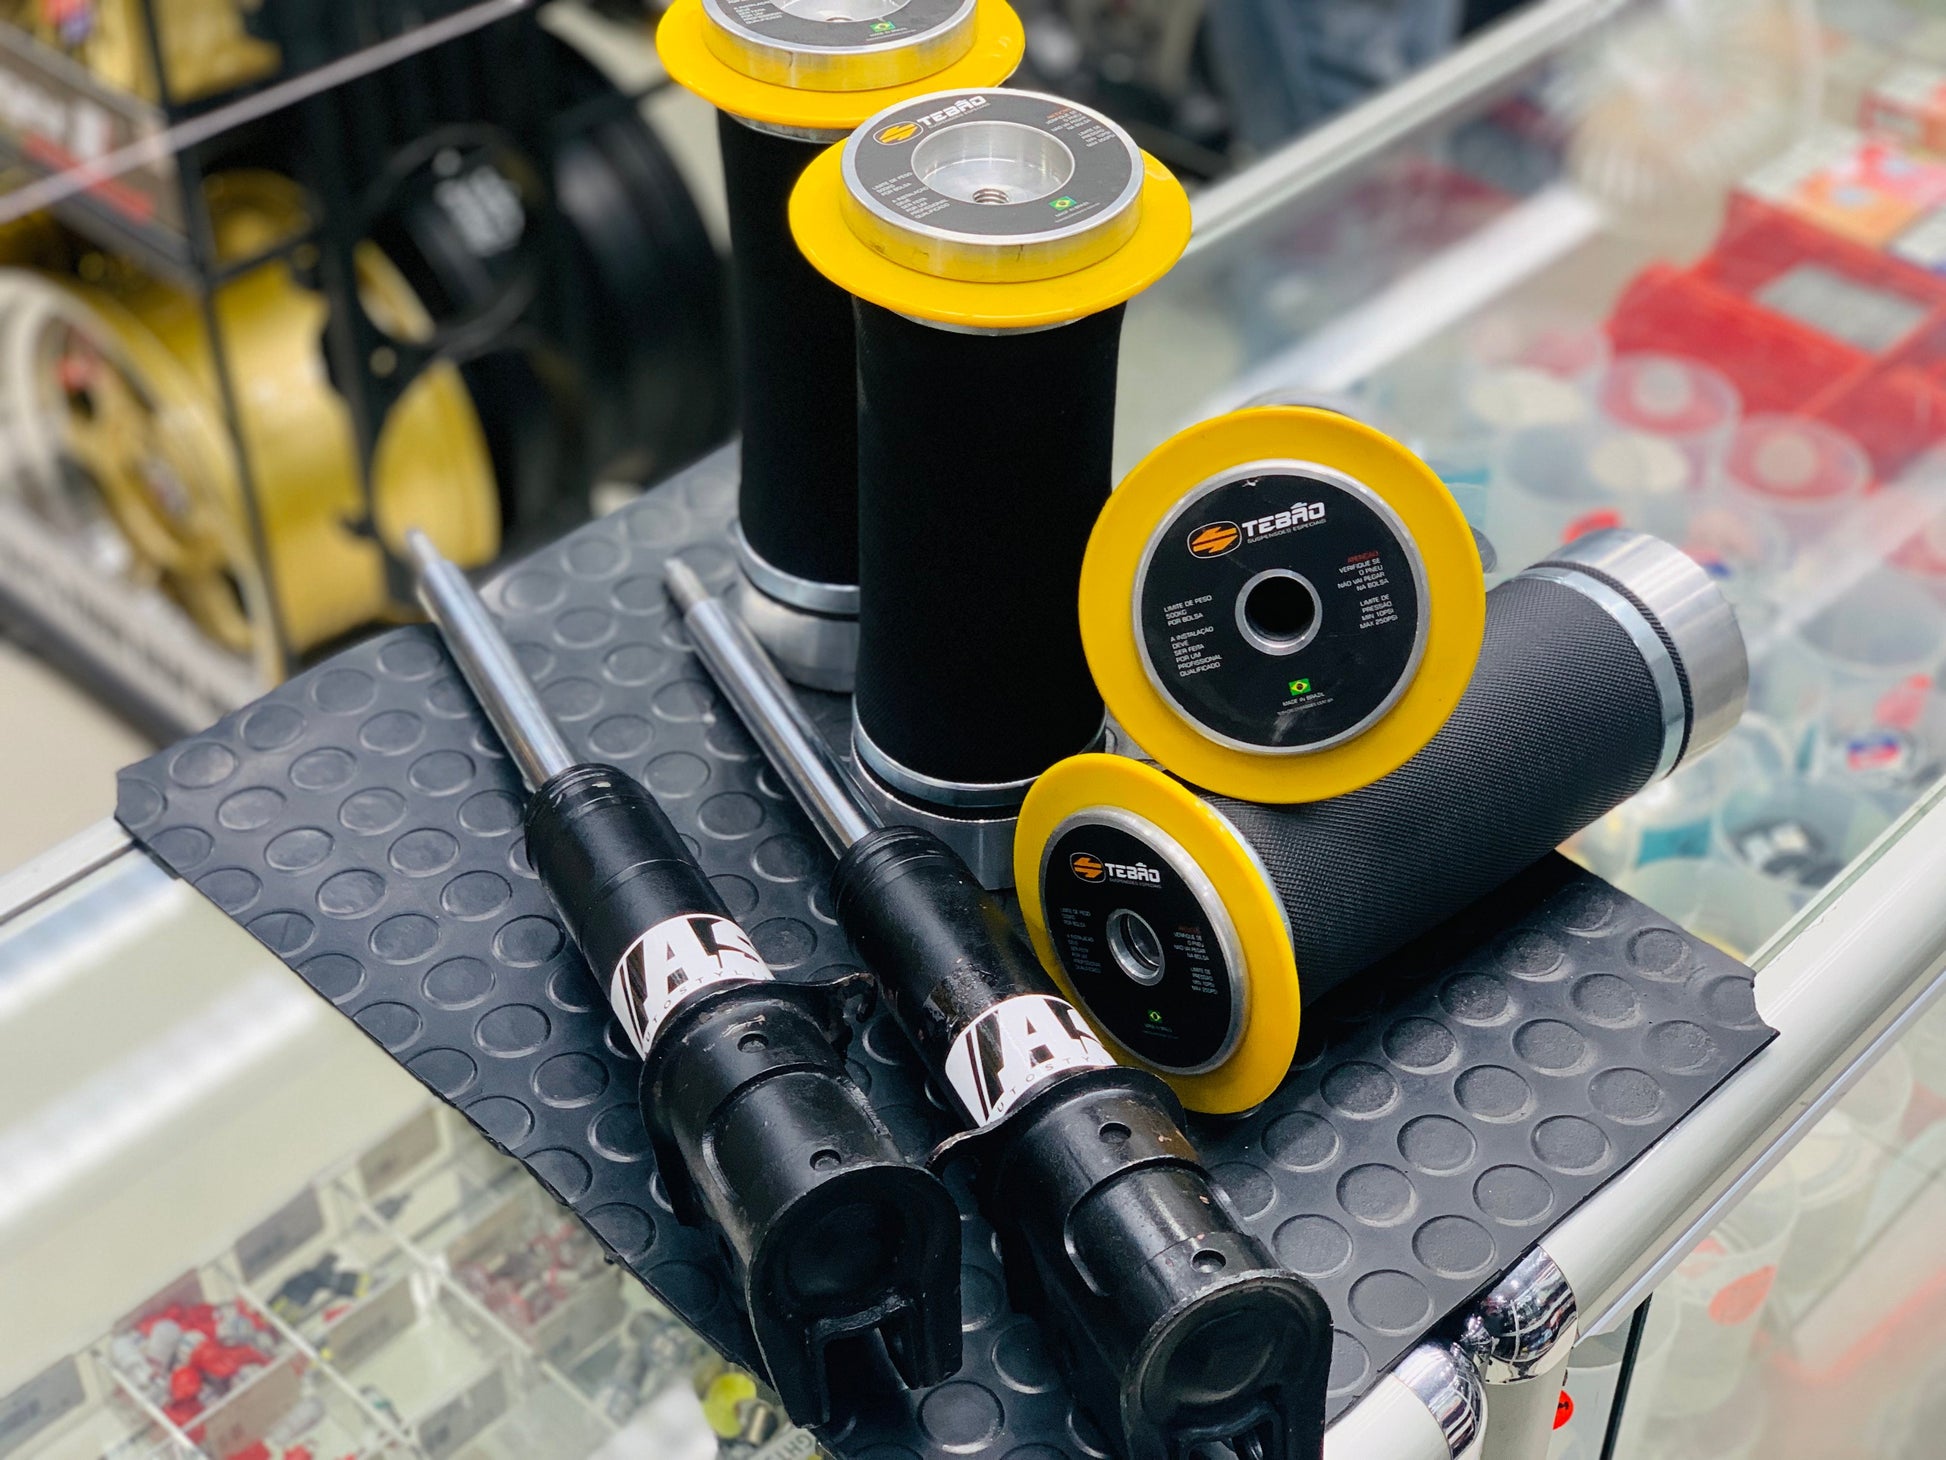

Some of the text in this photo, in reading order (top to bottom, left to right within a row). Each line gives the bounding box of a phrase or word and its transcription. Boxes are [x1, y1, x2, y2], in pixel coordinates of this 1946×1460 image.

[1242, 502, 1325, 537] TEBÃO
[1180, 662, 1220, 677] QUALIFICADO
[1104, 862, 1160, 883] TEBÃO
